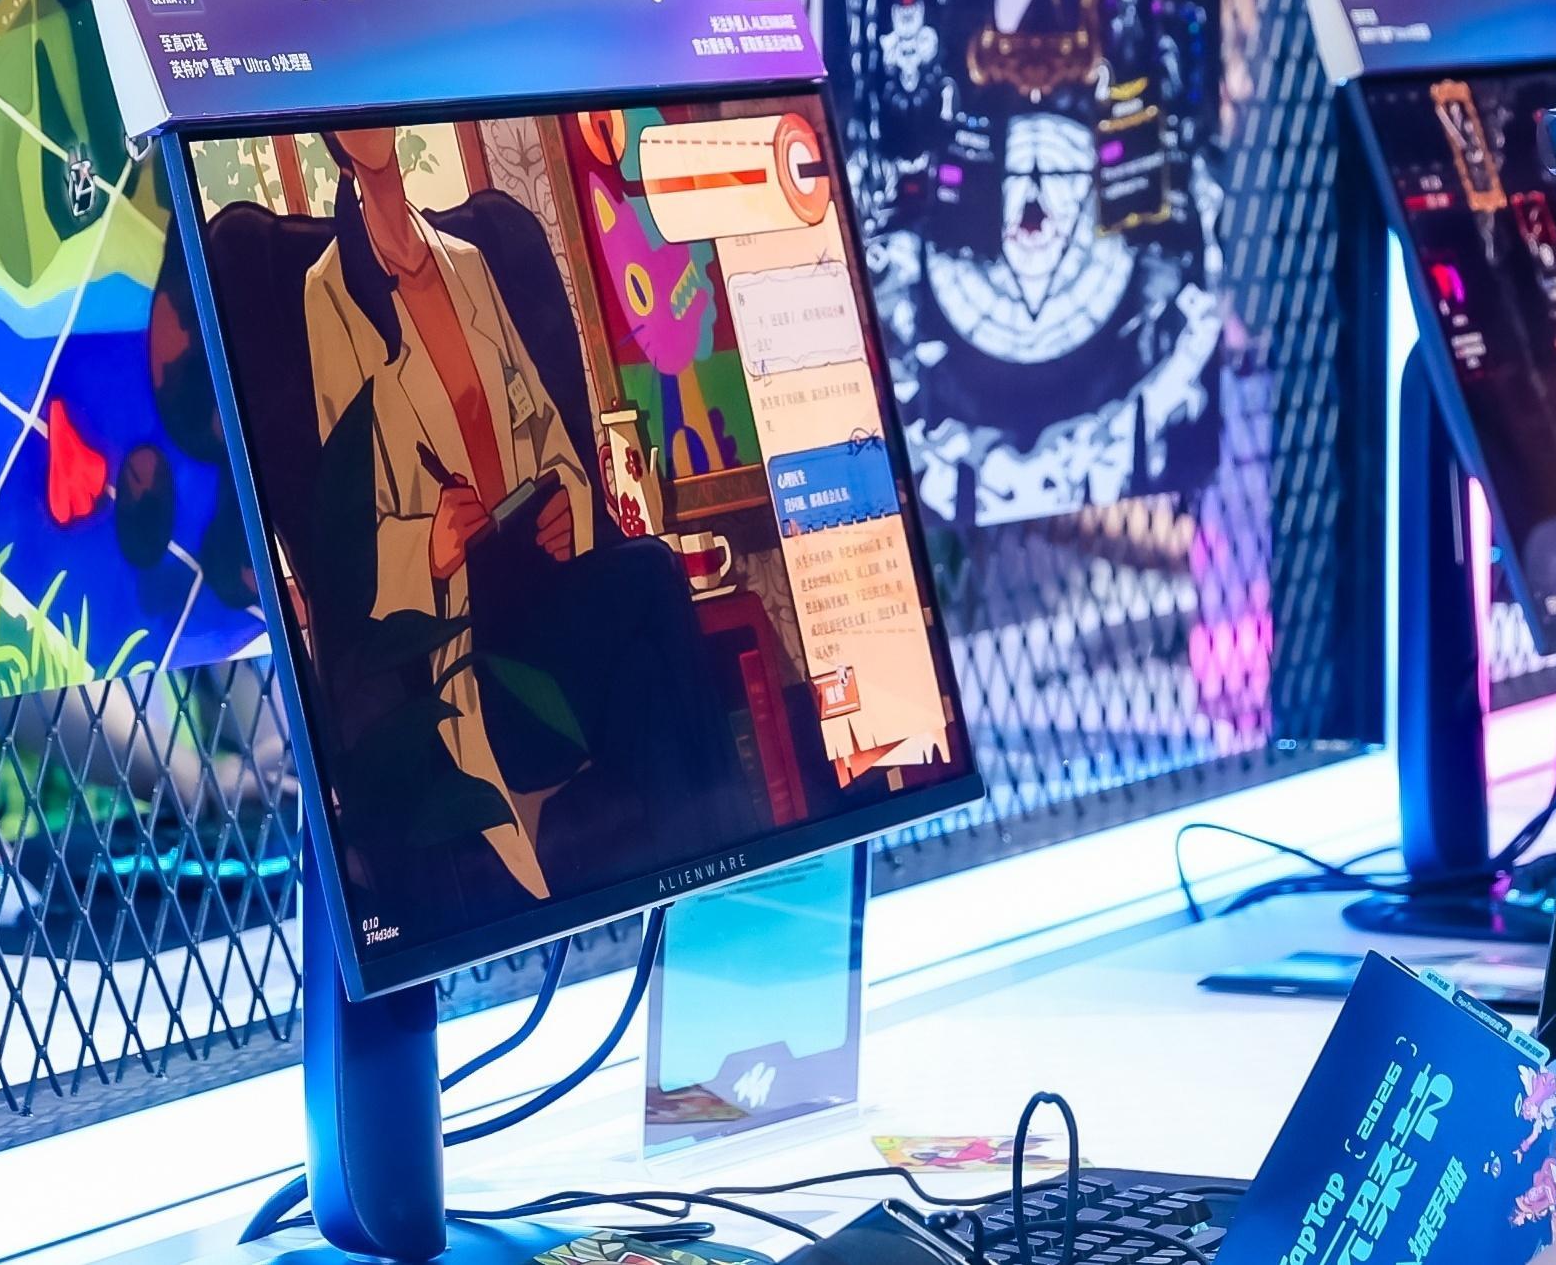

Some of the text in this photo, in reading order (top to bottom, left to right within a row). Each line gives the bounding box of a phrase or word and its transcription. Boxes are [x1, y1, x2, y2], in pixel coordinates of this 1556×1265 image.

[159, 32, 209, 53] 至高可选
[242, 56, 271, 74] Ultra
[658, 854, 747, 893] ALIENWARE
[1396, 1154, 1469, 1265] 城手册
